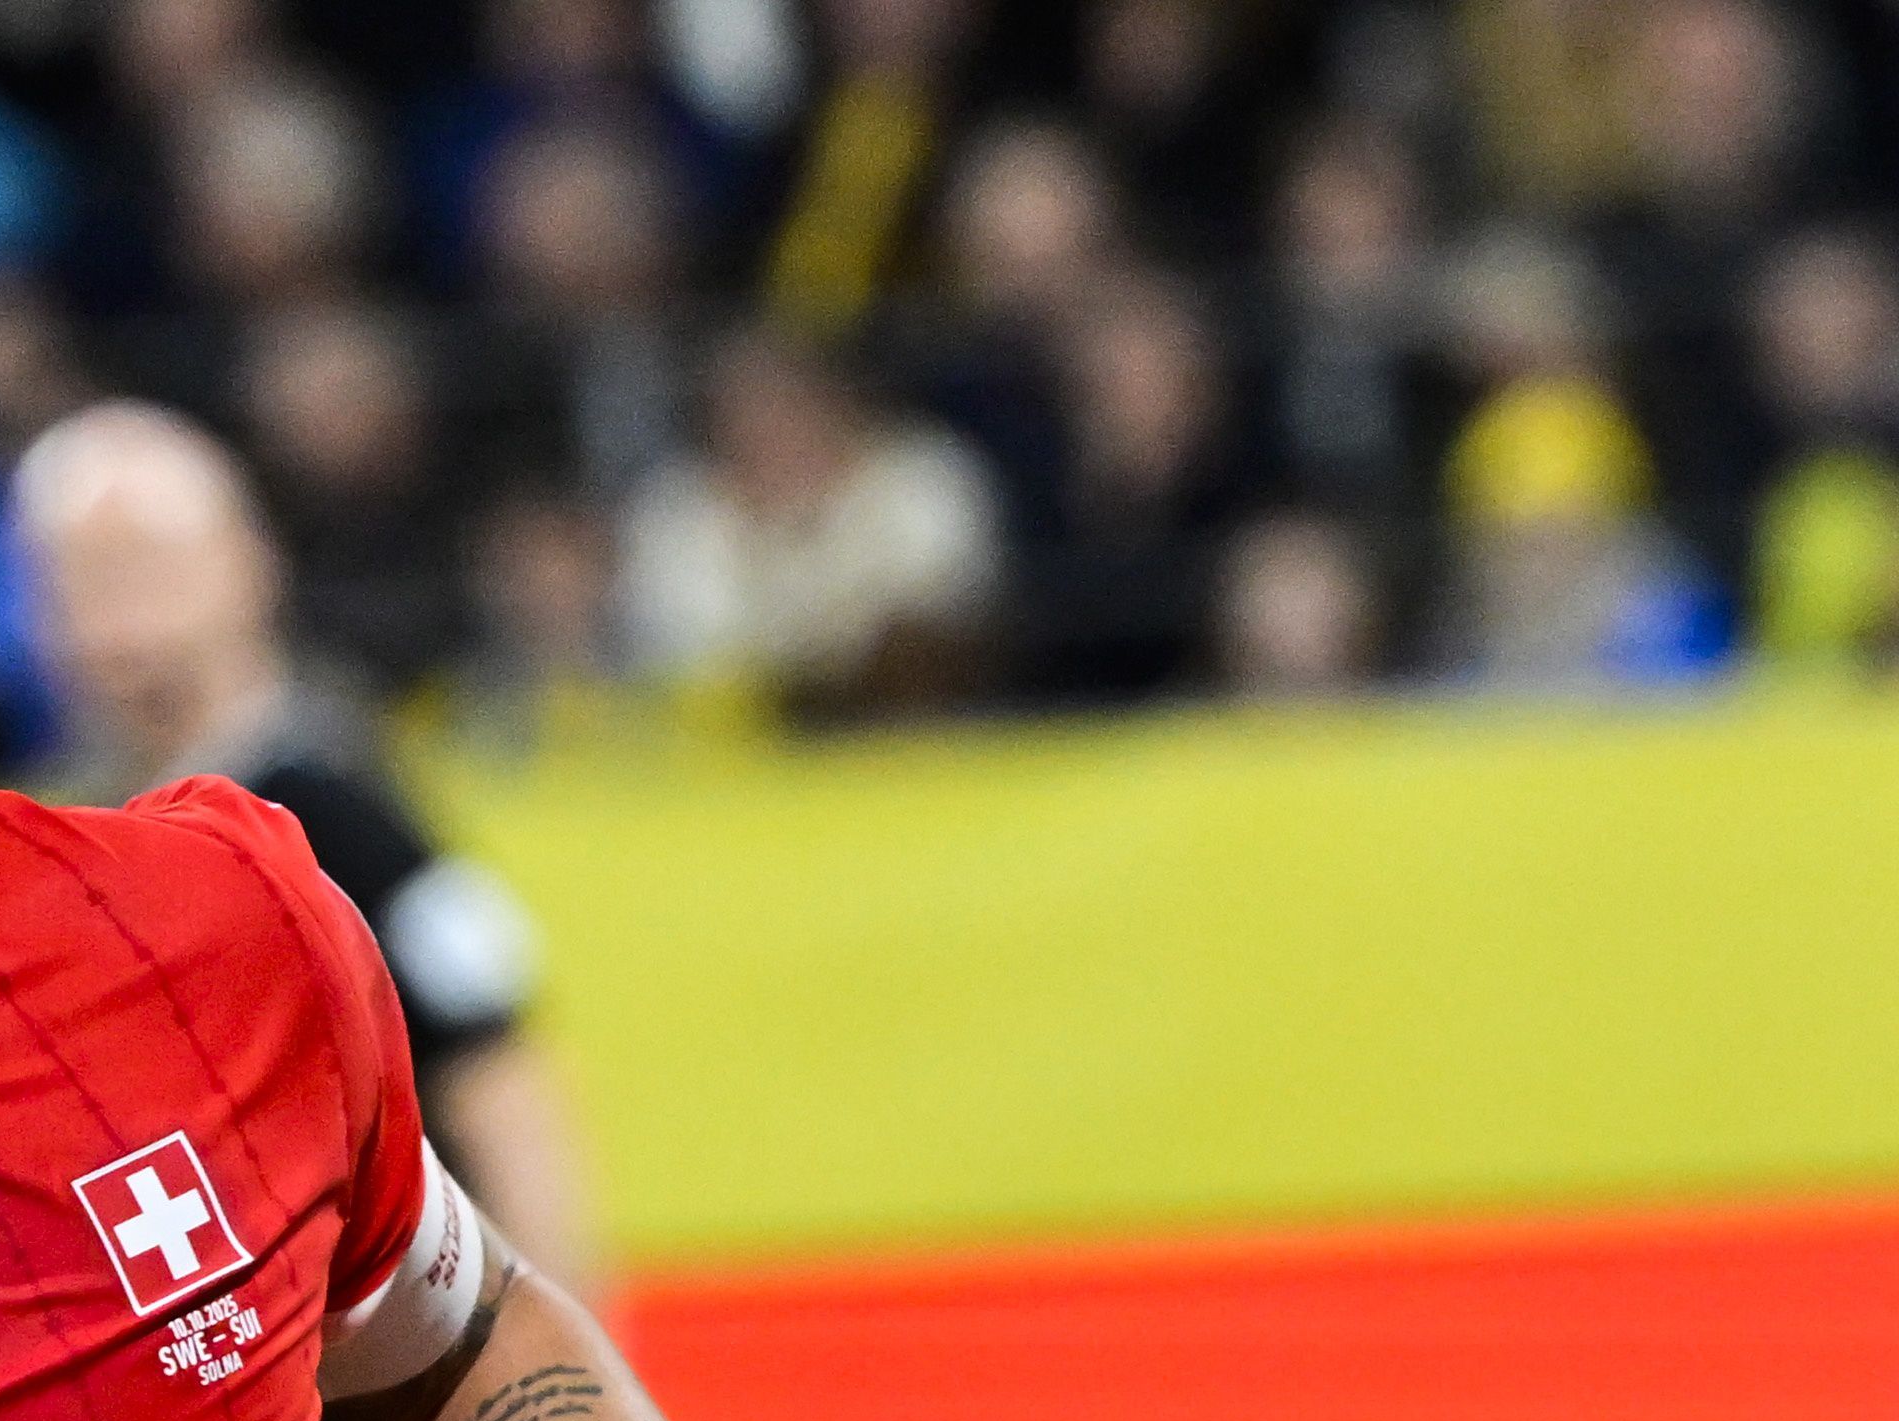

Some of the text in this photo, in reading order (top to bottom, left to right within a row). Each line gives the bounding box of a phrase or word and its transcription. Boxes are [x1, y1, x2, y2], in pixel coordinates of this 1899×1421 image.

[168, 1294, 238, 1340] 10.10.2025
[158, 1332, 212, 1376] SWE
[229, 1307, 263, 1345] SUI
[198, 1350, 243, 1385] SOLNA
